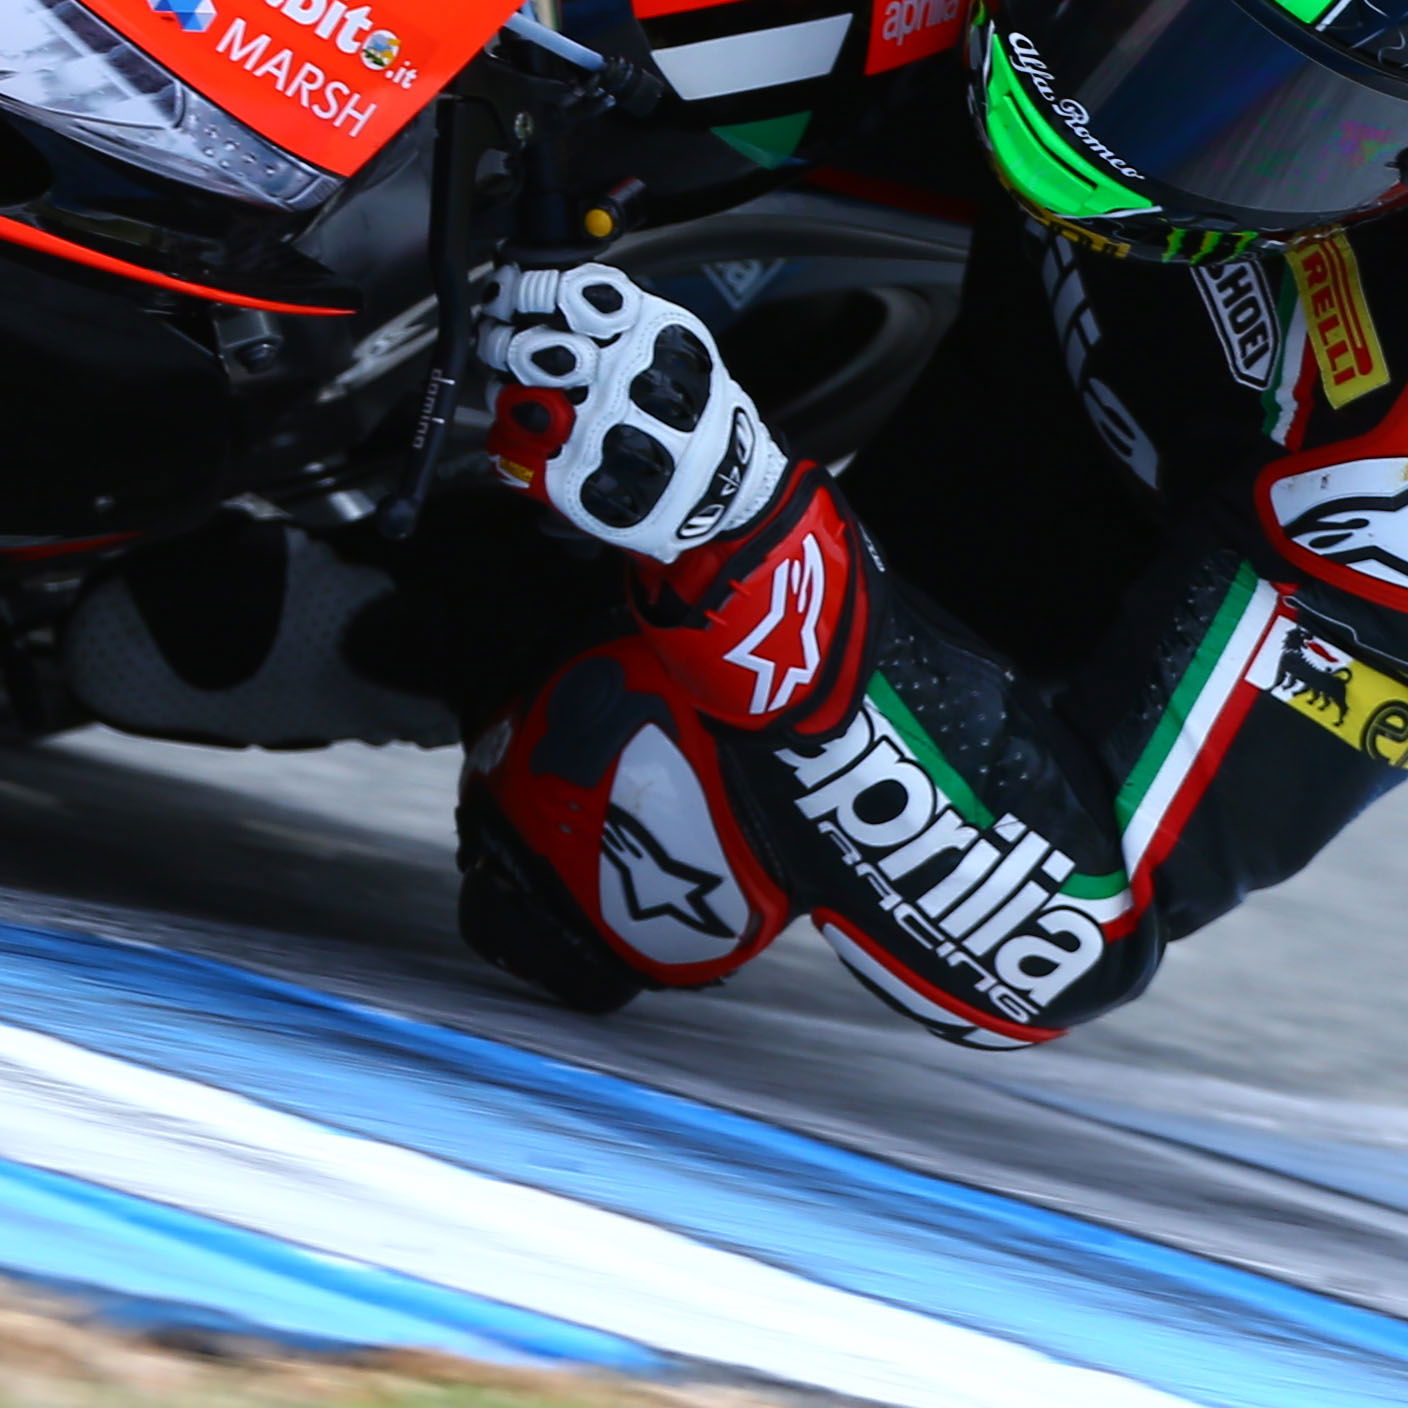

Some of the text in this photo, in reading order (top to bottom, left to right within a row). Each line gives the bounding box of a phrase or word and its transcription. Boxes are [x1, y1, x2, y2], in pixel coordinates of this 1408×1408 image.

[215, 17, 378, 137] MARSH
[1051, 98, 1146, 180] Romeo
[413, 368, 455, 450] domino
